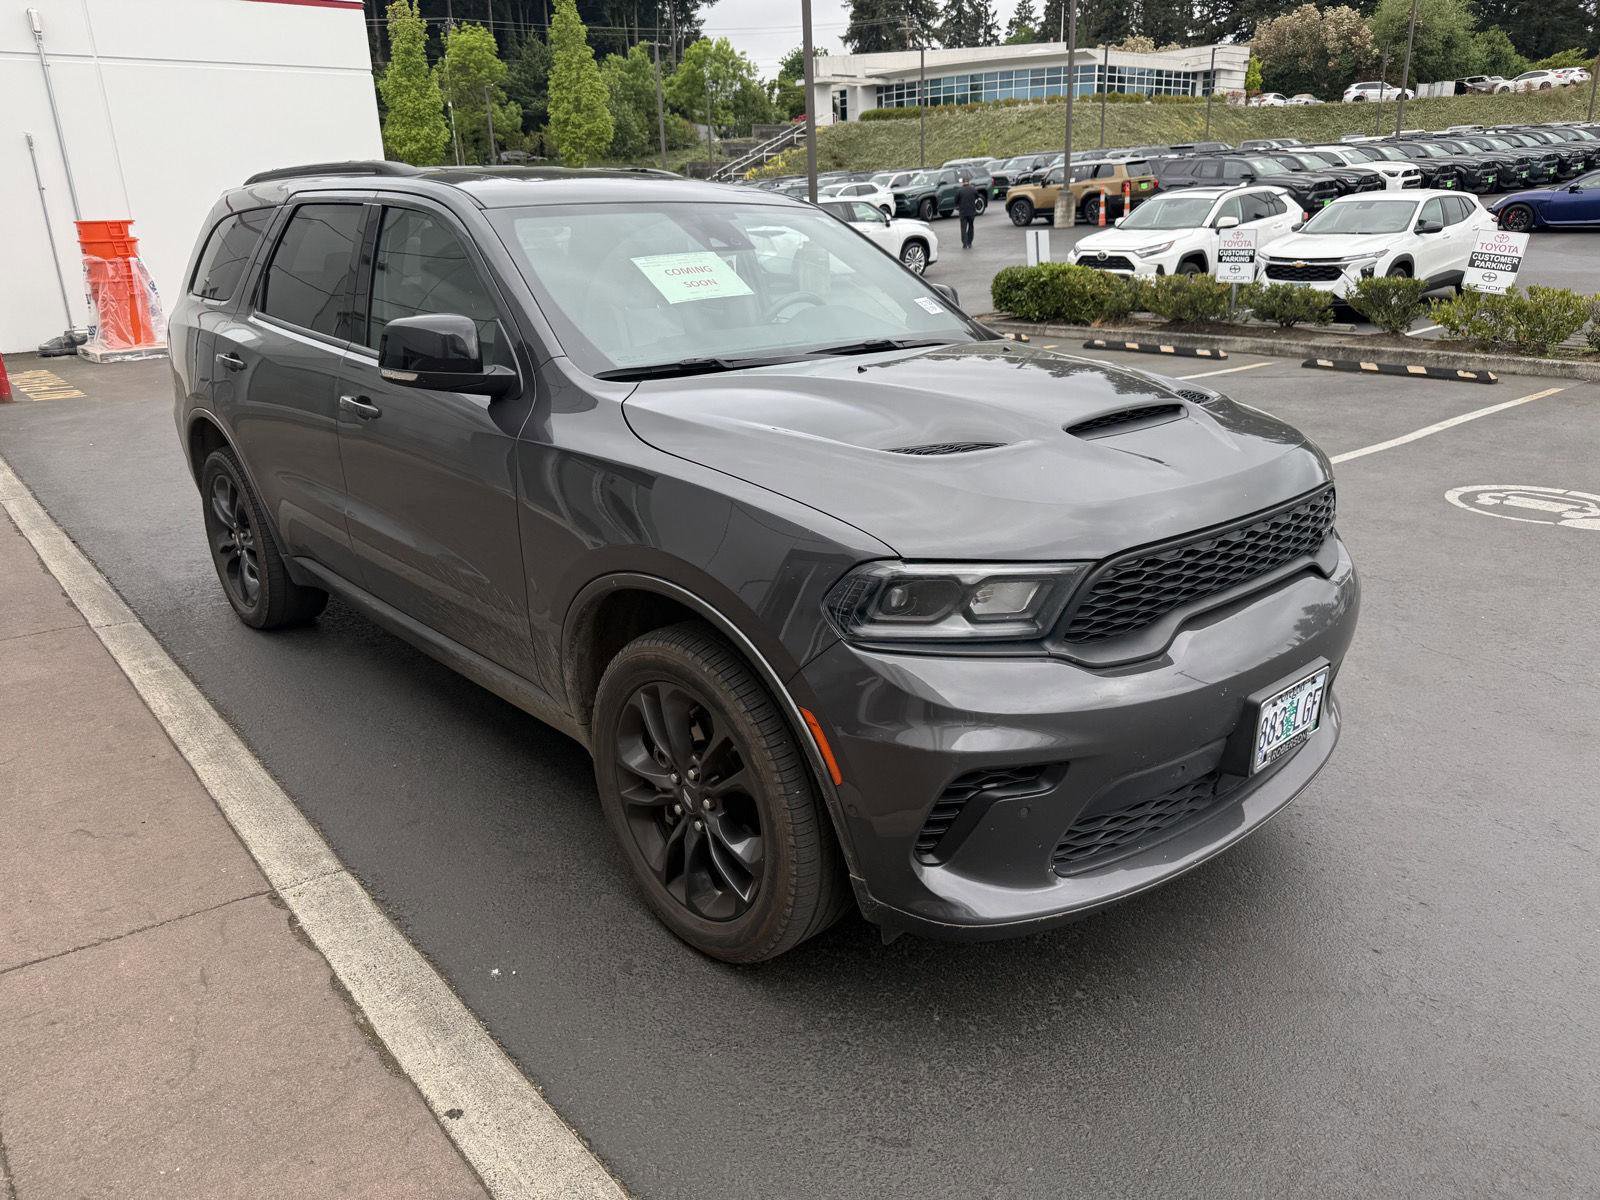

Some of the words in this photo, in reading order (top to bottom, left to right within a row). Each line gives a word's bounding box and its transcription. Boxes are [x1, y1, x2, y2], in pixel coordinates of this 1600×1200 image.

[1480, 242, 1518, 254] TOYOTA
[1472, 253, 1519, 264] CUSTOMER
[664, 265, 713, 276] COMING
[1474, 261, 1512, 270] PARKING
[683, 278, 718, 289] SOON
[1259, 707, 1287, 751] 883
[1293, 686, 1323, 730] LGF
